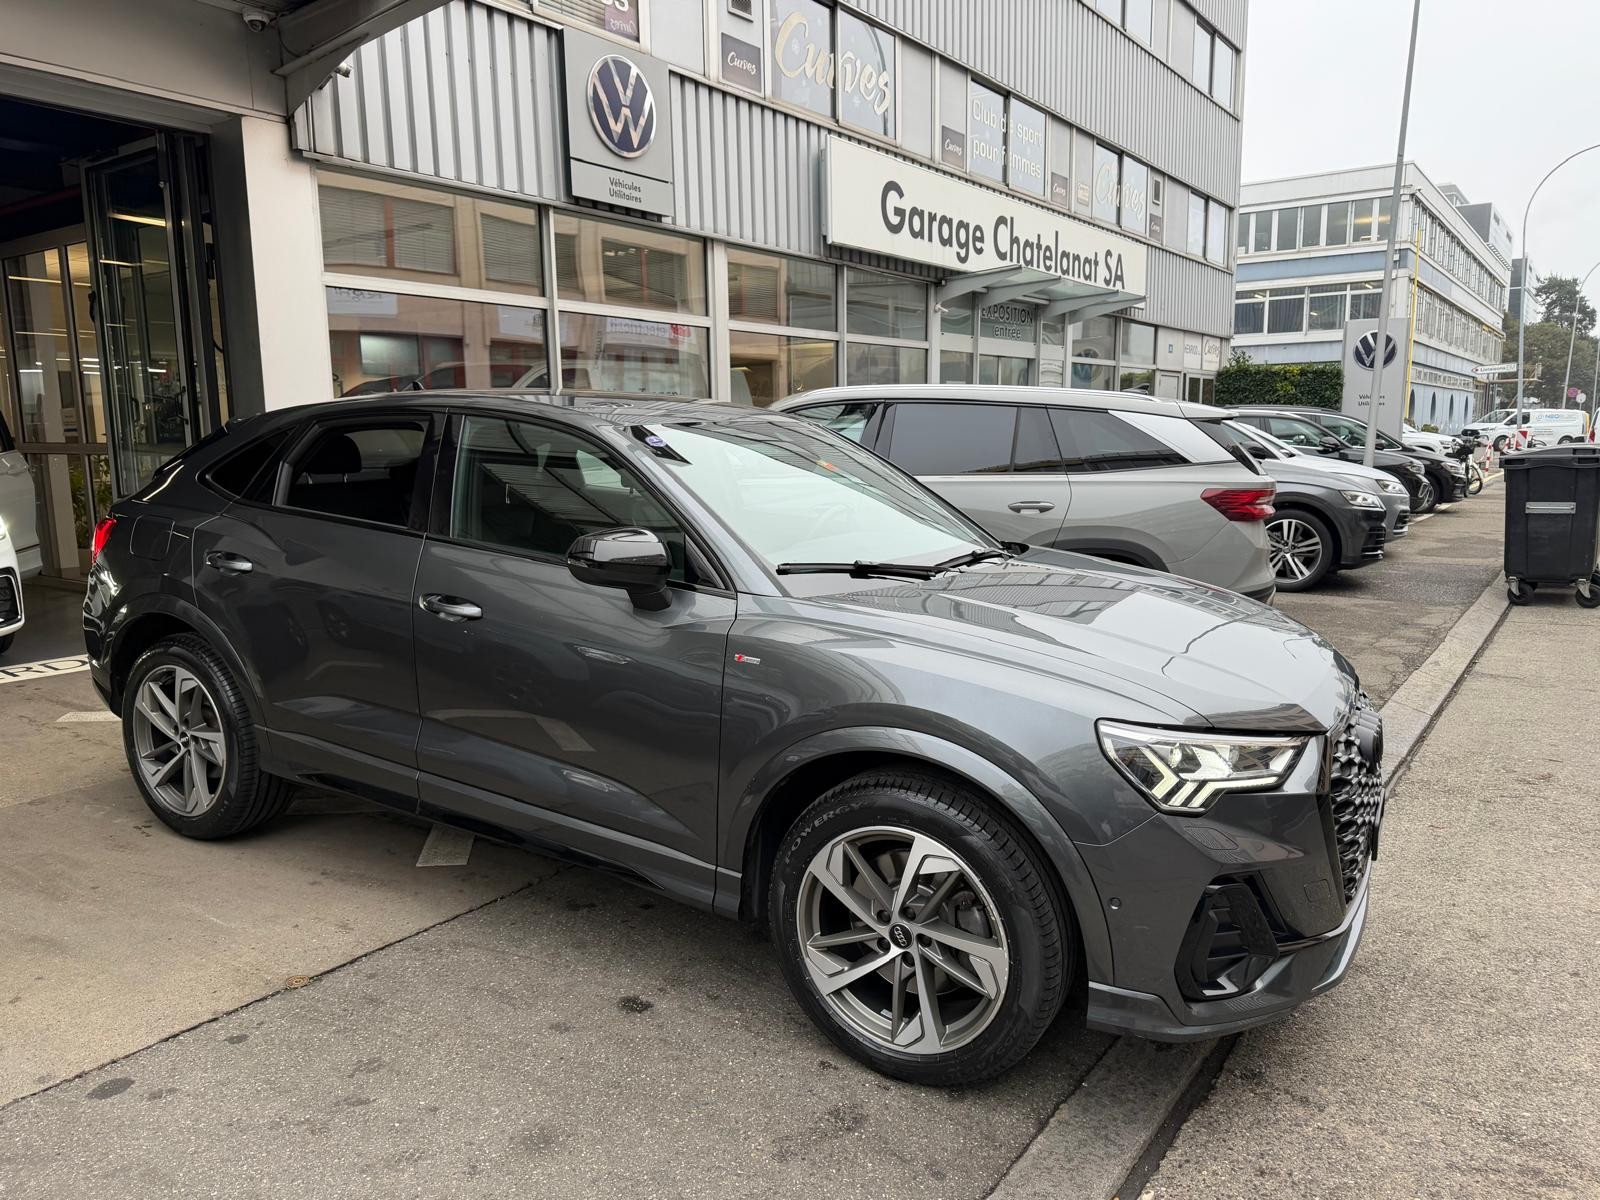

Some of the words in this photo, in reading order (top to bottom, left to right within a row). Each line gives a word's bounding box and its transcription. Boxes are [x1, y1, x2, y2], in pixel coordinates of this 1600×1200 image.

[727, 51, 757, 75] Curves
[775, 11, 891, 116] Curves
[973, 100, 996, 129] Club
[1018, 123, 1042, 146] sport
[973, 138, 998, 162] pour
[1002, 145, 1041, 178] fmmes
[609, 176, 641, 192] Véhicules
[609, 187, 642, 203] Utilitaires
[881, 180, 985, 264] Garage
[993, 215, 1099, 283] Chatelanat
[1103, 249, 1125, 290] SA
[0, 659, 89, 679] RD
